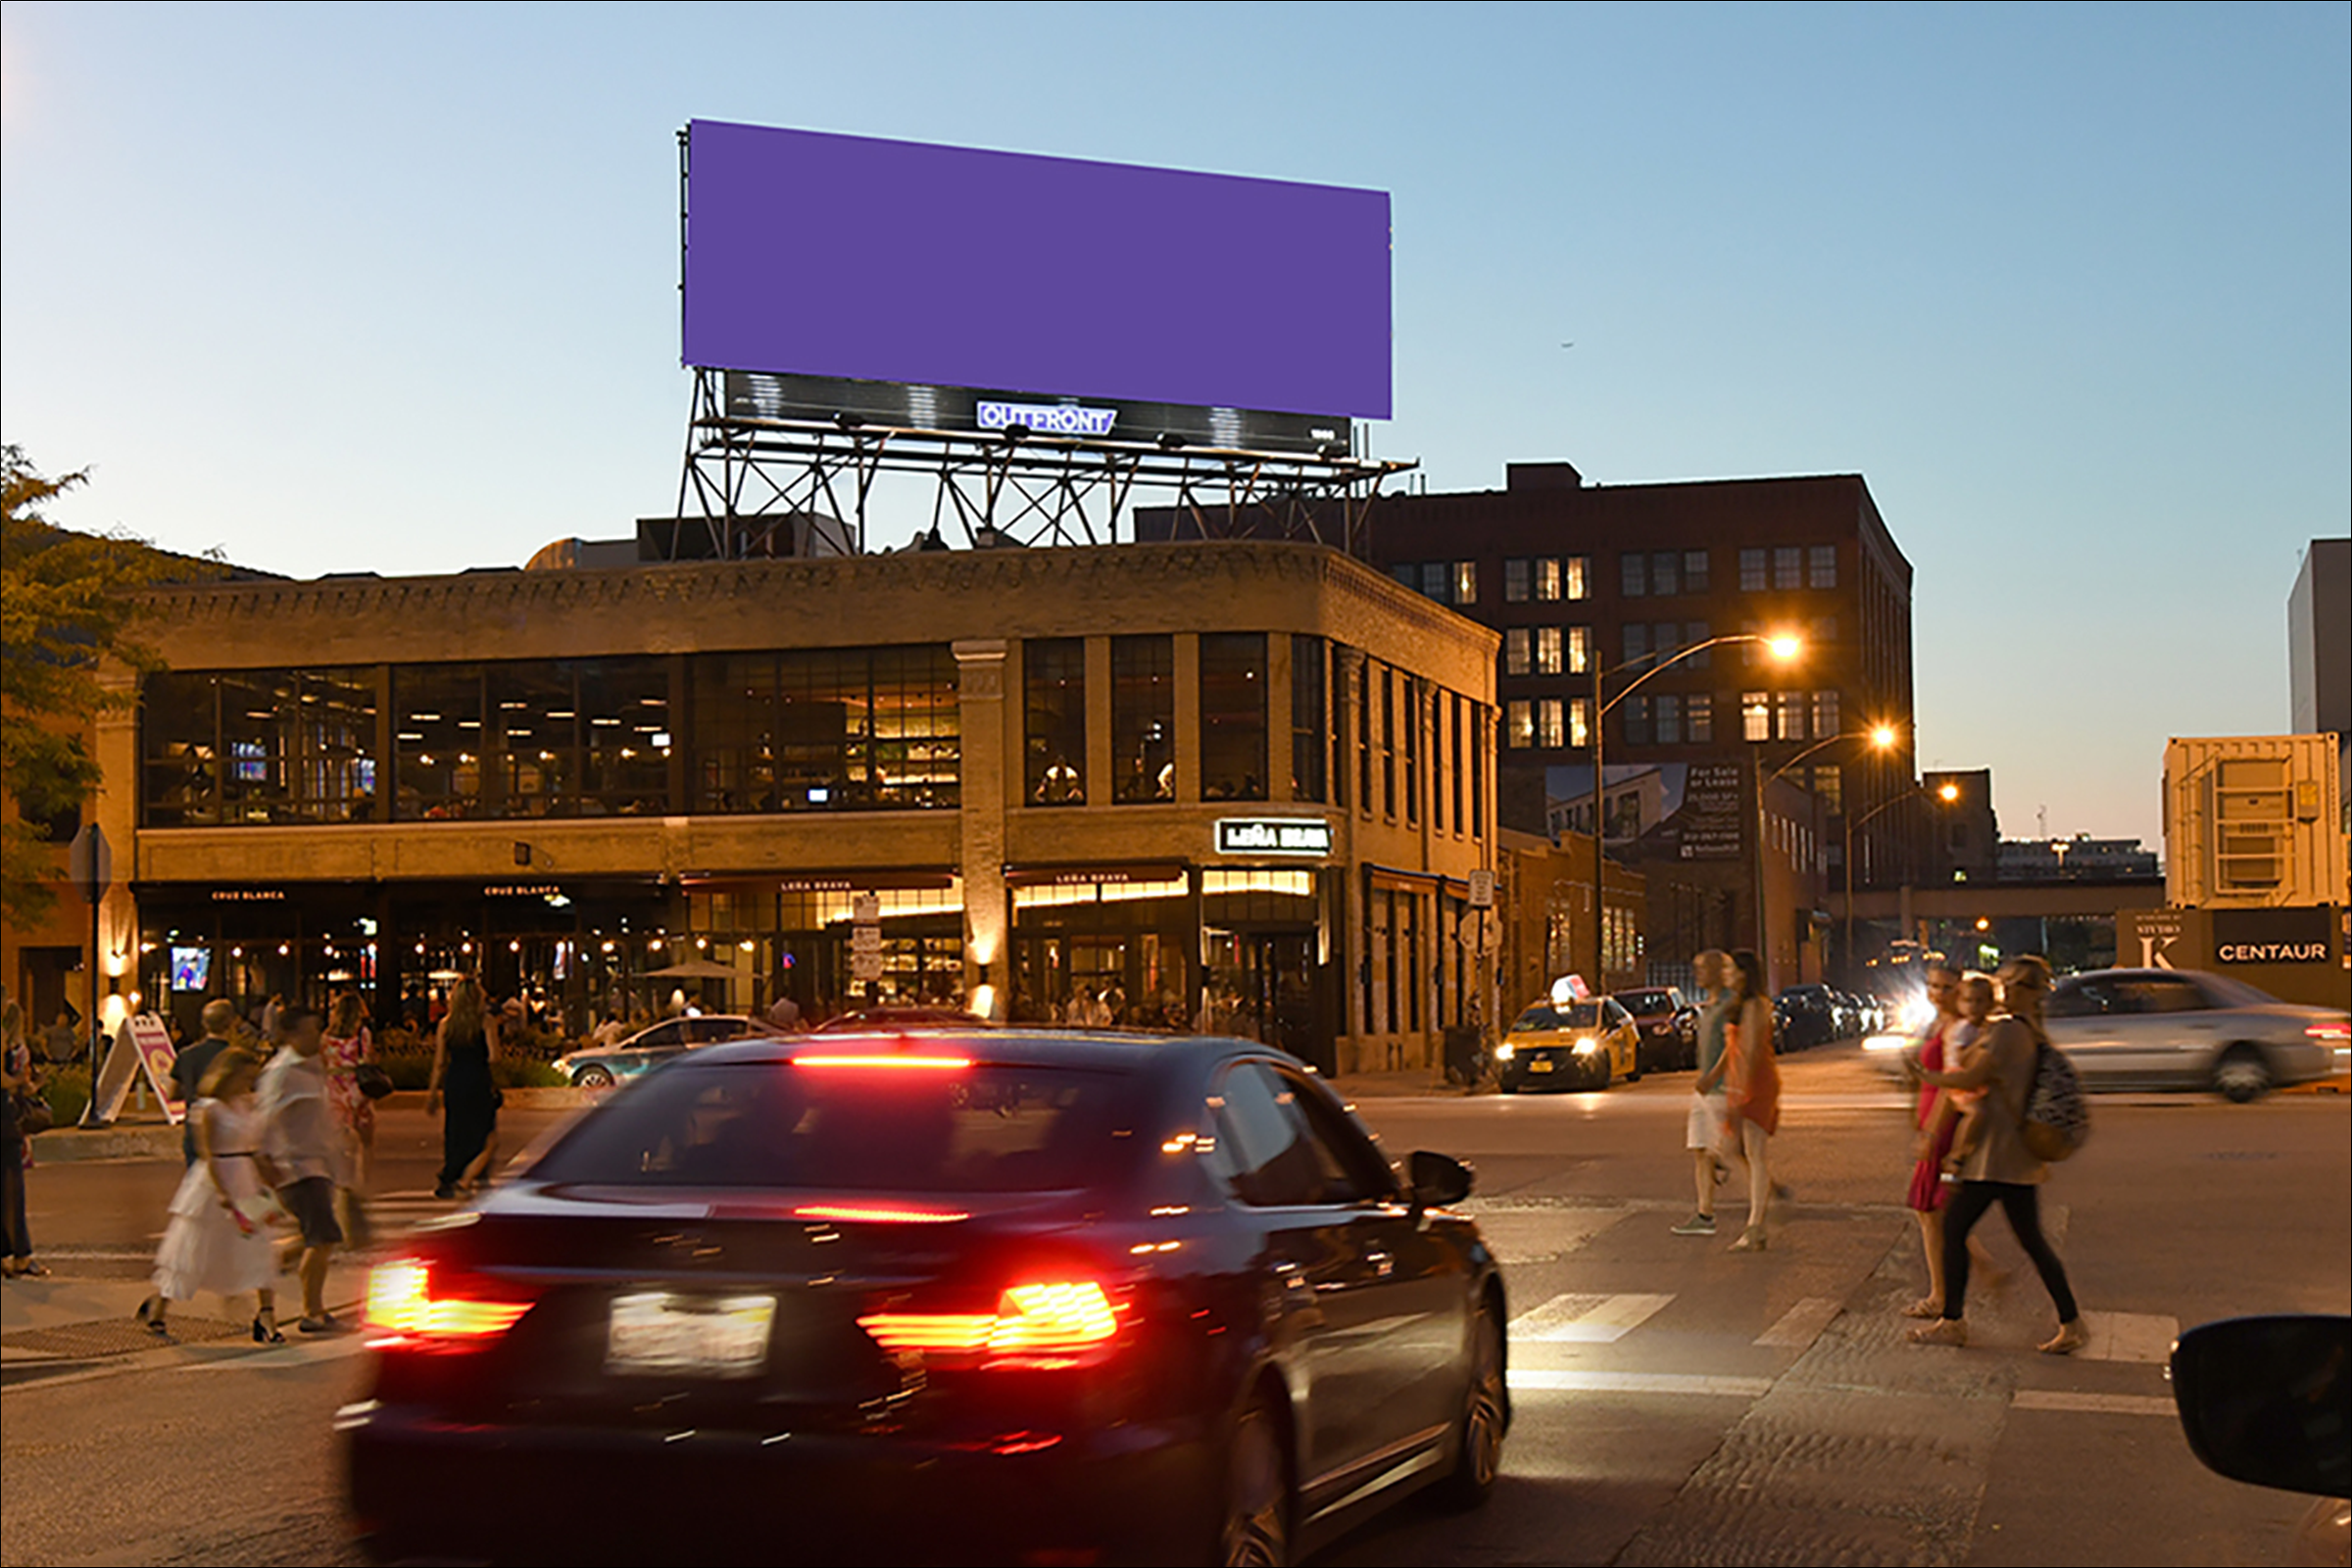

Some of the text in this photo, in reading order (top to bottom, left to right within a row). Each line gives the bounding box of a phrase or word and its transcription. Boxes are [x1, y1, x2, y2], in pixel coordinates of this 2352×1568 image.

[983, 405, 1109, 432] OUTFRONT
[1690, 766, 1739, 777] For Sale
[1705, 777, 1739, 789] Lease
[2219, 943, 2326, 961] CENTAUR
